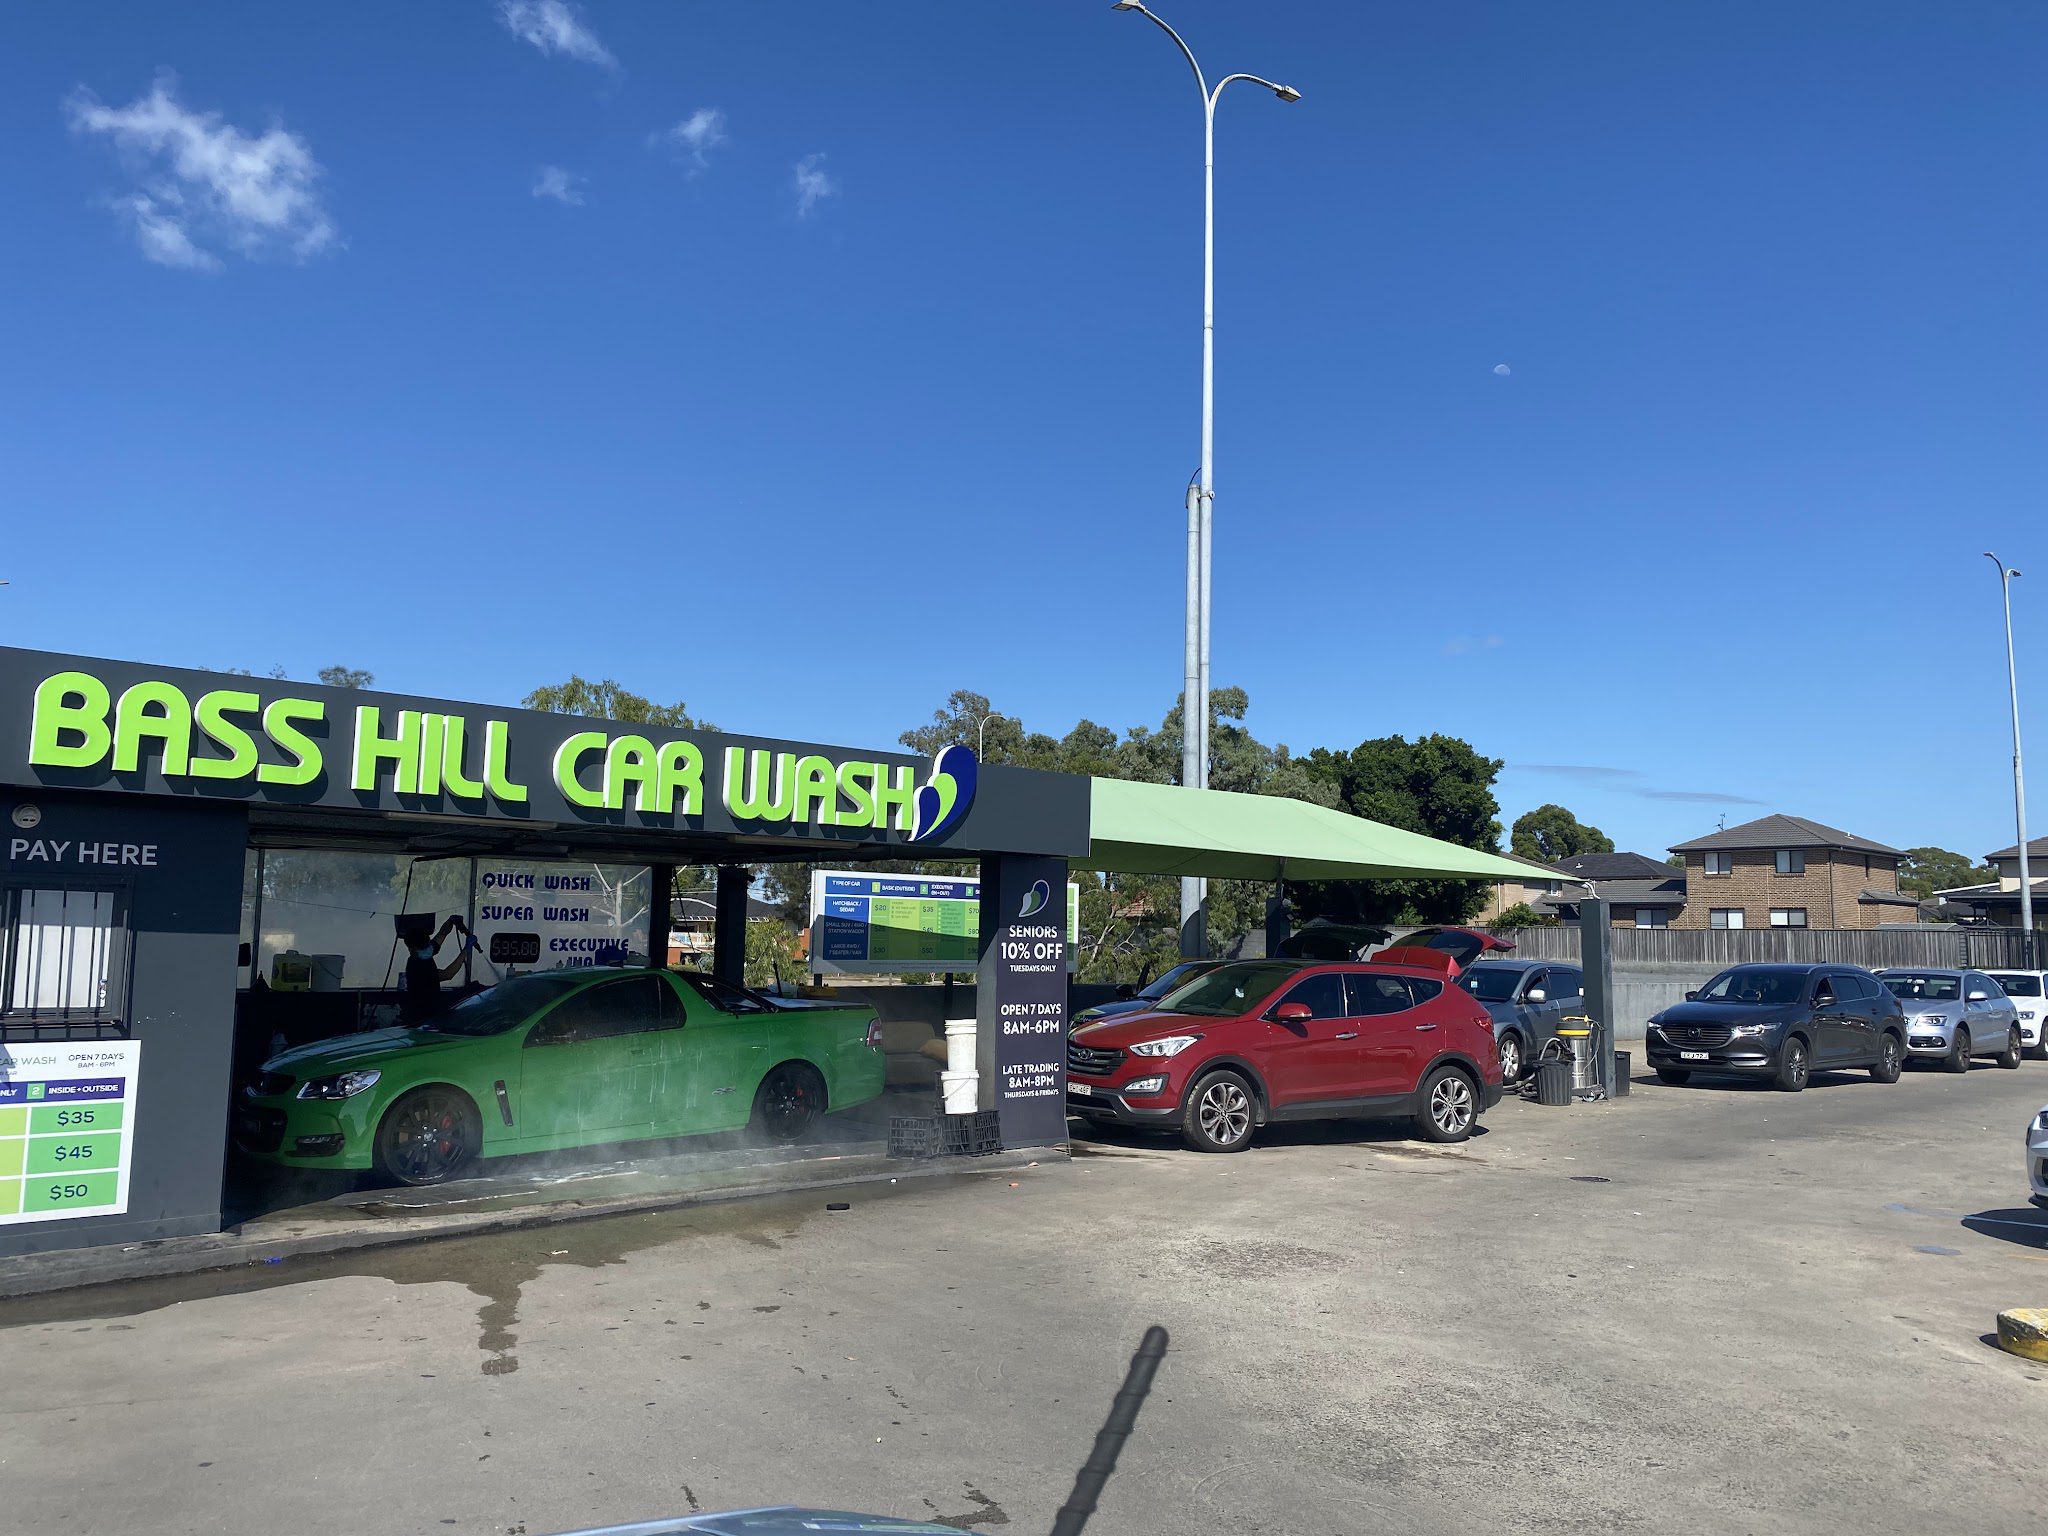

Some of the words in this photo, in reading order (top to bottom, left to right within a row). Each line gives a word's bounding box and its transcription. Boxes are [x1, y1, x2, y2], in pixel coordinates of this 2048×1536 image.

[29, 671, 325, 786] BASS
[351, 705, 527, 801] HILL
[553, 732, 703, 815] CAR
[723, 746, 914, 831] WASH
[10, 838, 71, 862] PAY
[78, 842, 158, 866] HERE
[482, 872, 535, 889] QUICK
[544, 875, 590, 890] WASH
[481, 906, 534, 920] SUPER
[543, 907, 589, 921] WASH
[922, 905, 934, 913] $35
[1009, 925, 1058, 939] SENIORS
[549, 938, 629, 951] EXECUTIVE
[1001, 942, 1031, 960] 10%
[1033, 942, 1063, 960] OFF
[1000, 1004, 1029, 1016] OPEN
[1030, 1004, 1036, 1015] 7
[1037, 1003, 1062, 1015] DAYS
[1003, 1020, 1060, 1035] 8AM-6PM
[20, 1056, 57, 1065] WASH
[1002, 1065, 1023, 1075] LATE
[1023, 1063, 1060, 1074] TRADING
[1008, 1075, 1054, 1088] 8AM-8PM
[0, 1089, 18, 1097] NLY
[31, 1087, 40, 1095] 2
[1004, 1090, 1035, 1099] THURSDAYS
[1039, 1088, 1060, 1096] FRIDAYS
[57, 1110, 95, 1127] $35
[54, 1145, 93, 1162] $45
[49, 1184, 88, 1201] $50
